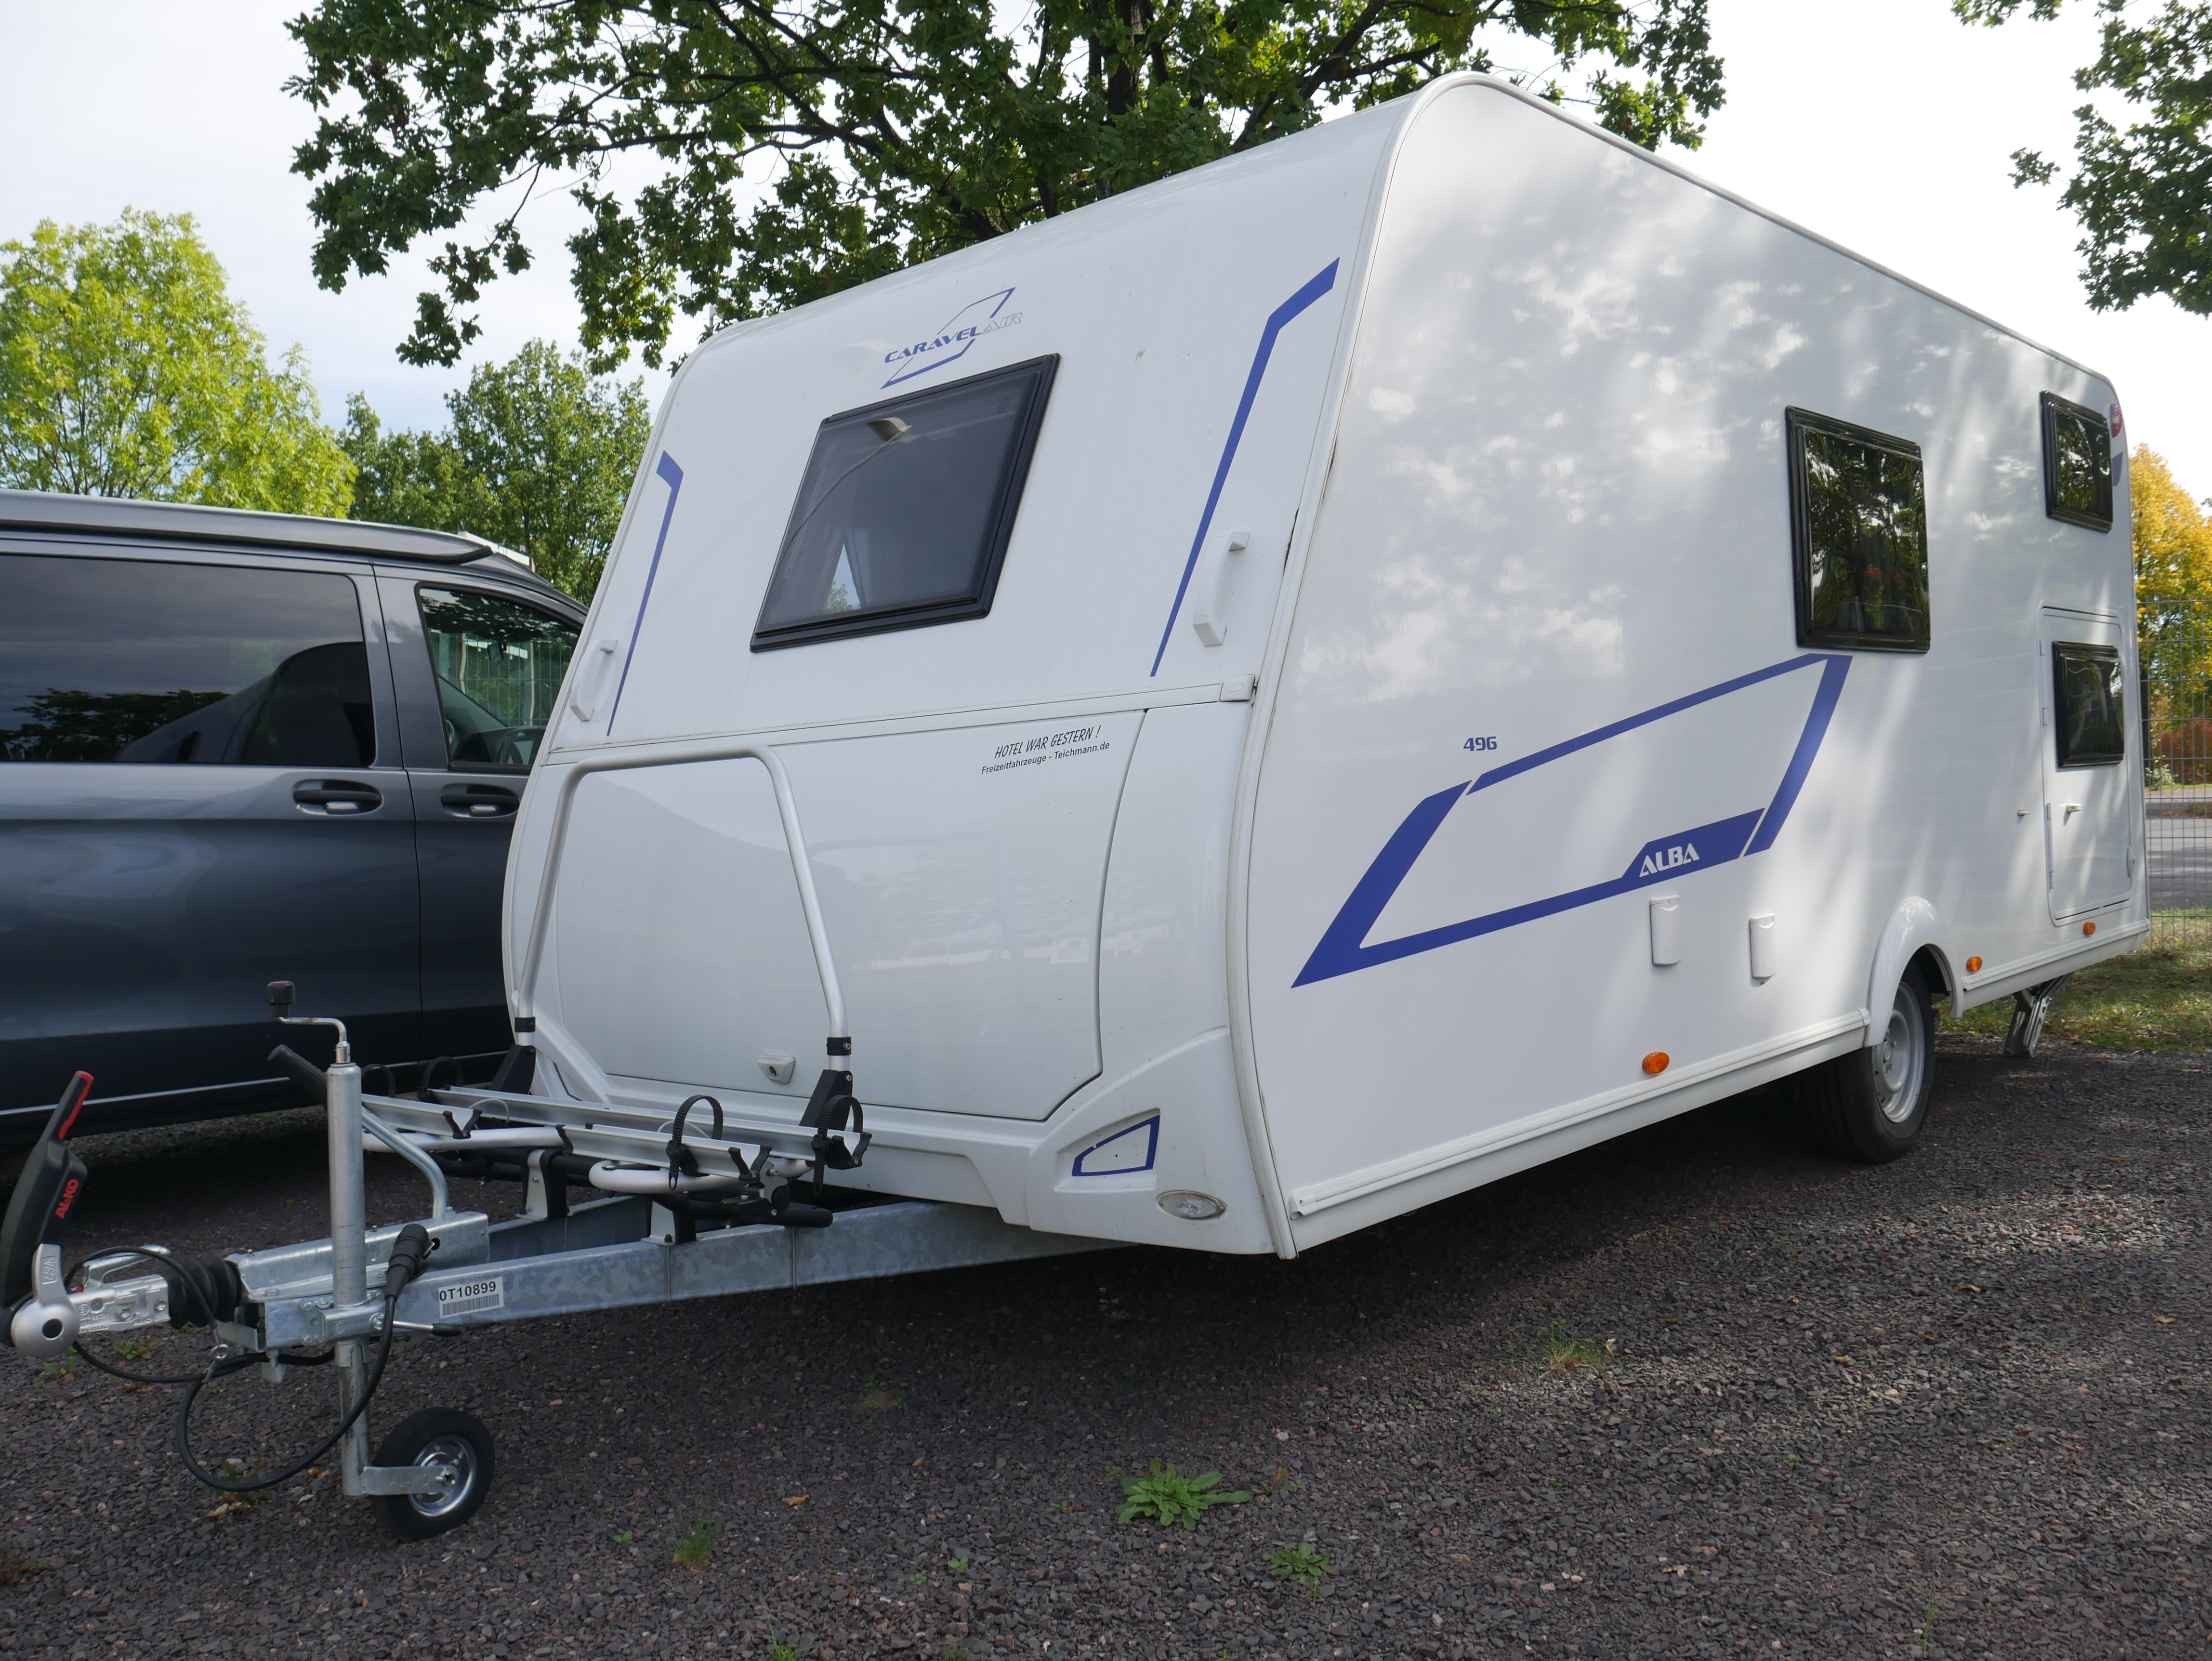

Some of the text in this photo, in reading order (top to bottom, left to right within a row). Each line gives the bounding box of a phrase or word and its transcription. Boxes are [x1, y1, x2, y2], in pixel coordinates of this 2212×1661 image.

[884, 313, 1022, 363] CARAVELAIR
[981, 756, 1047, 774] Freizeitfahrzeuge
[1054, 742, 1110, 759] Teichmann.de
[994, 725, 1101, 759] HOTEL WAR GESTERN !
[1463, 736, 1498, 751] 496
[1639, 843, 1699, 877] ALBA
[55, 1179, 79, 1219] AL-KO
[439, 1281, 496, 1301] 0T10899
